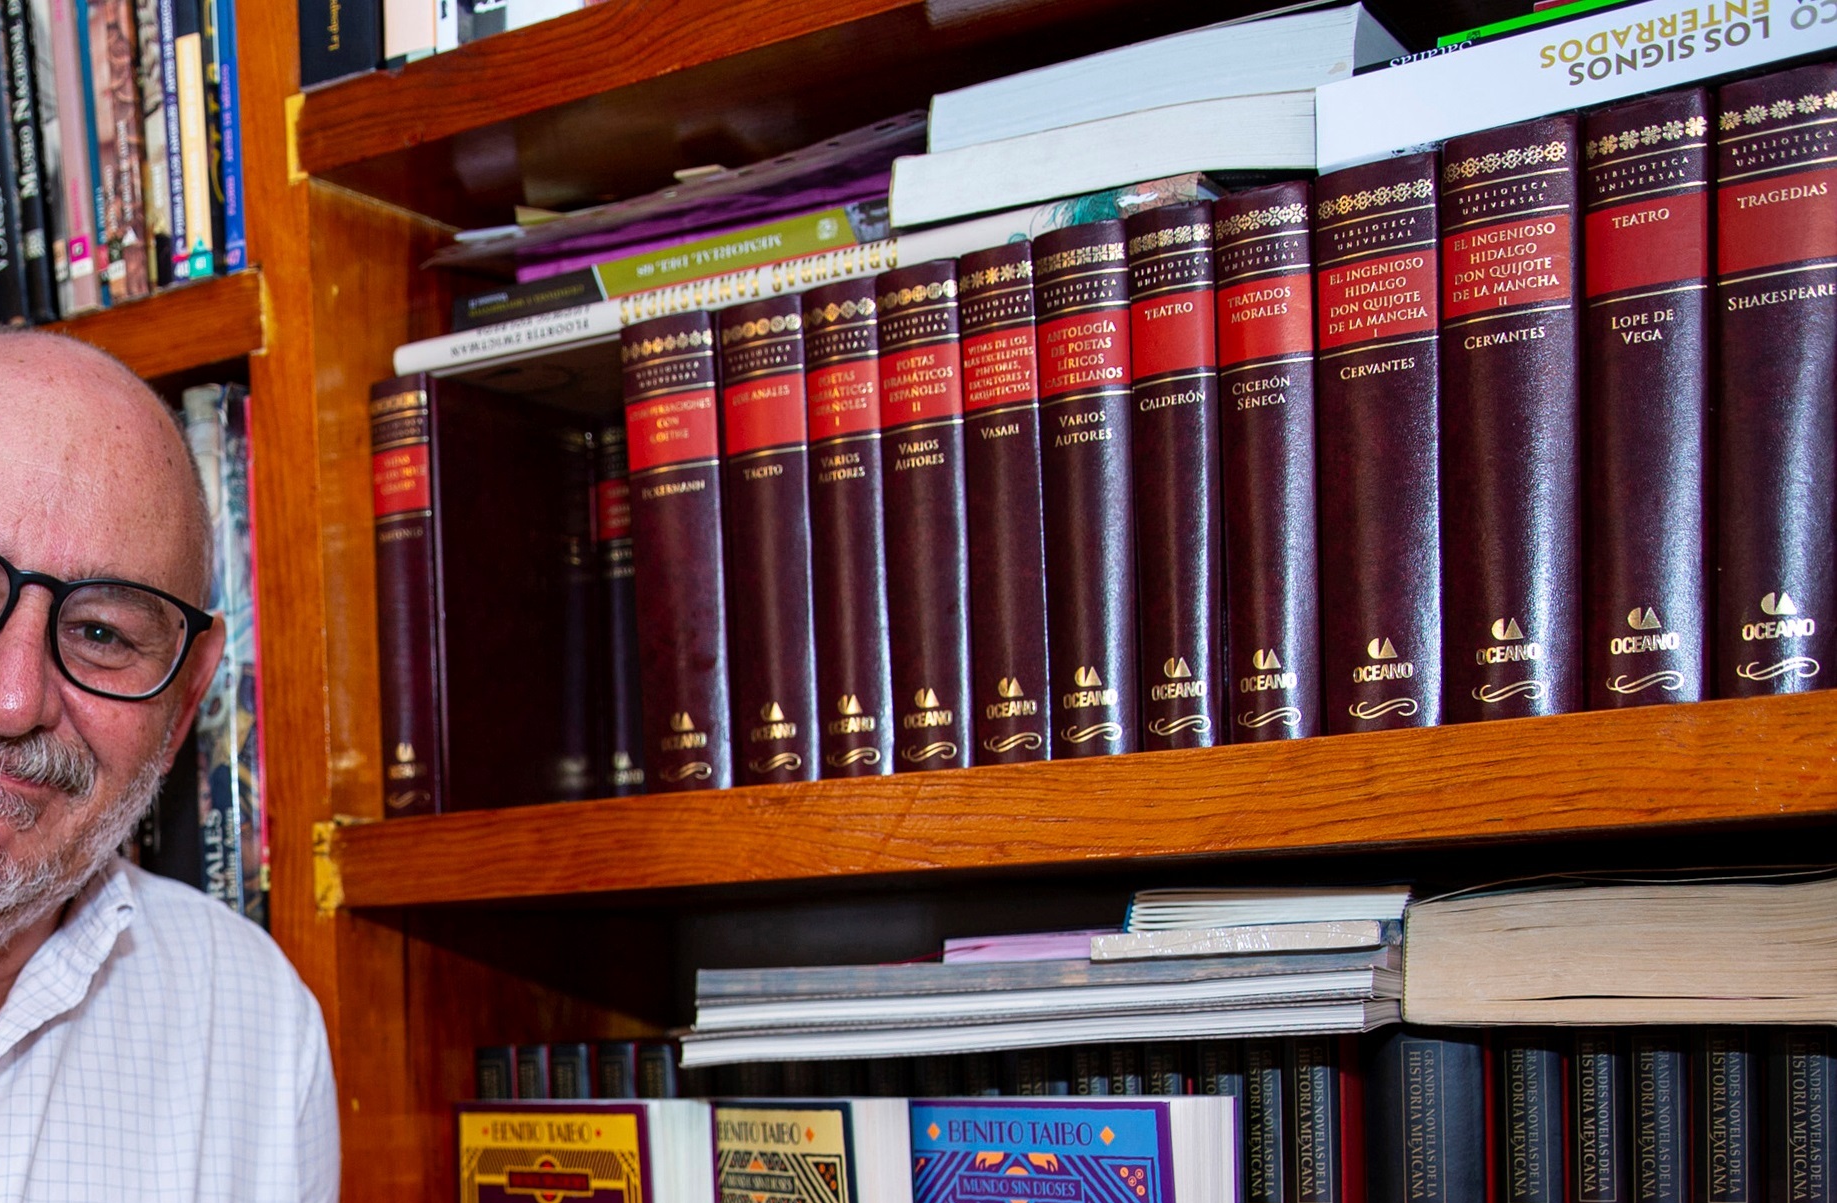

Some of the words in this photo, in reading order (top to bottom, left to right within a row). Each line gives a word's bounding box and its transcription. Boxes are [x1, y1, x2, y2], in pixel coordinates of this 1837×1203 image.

[1539, 0, 1770, 68] ENTERRADOS
[1706, 15, 1770, 52] LOS
[1568, 34, 1695, 85] SIGNOS
[1732, 129, 1835, 156] BIBLIOTECA
[1736, 142, 1830, 167] UNIVERSAL
[1737, 183, 1828, 210] TRAGEDIAS
[1333, 216, 1417, 241] BIBLIOTECA
[1612, 208, 1670, 229] TEATRO
[1337, 229, 1413, 251] UNIVERSAL
[772, 237, 898, 293] CRIATURAS
[1329, 273, 1344, 286] EL
[1346, 257, 1424, 283] INGENIOSO
[1227, 286, 1291, 310] TRATADOS
[1345, 276, 1407, 298] HIDALGO
[1728, 281, 1836, 312] SHAKESPEARE
[1145, 301, 1193, 321] TEATRO
[1230, 303, 1288, 324] MORALES
[1330, 303, 1359, 318] DON
[1362, 290, 1421, 316] QUIJOTE
[1329, 322, 1345, 335] DE
[1348, 317, 1363, 331] LA
[1366, 307, 1428, 329] MANCHA
[1611, 312, 1646, 330] LOPE
[1652, 308, 1675, 325] DE
[1046, 320, 1116, 344] ANTOLOGÍA
[1464, 325, 1546, 350] CERVANTES
[1620, 327, 1663, 346] VEGA
[1051, 345, 1065, 358] DE
[1068, 337, 1112, 355] POETAS
[1057, 352, 1104, 371] LÍRICOS
[1340, 357, 1415, 380] CERVANTES
[1044, 366, 1123, 389] CASTELLANOS
[1232, 375, 1291, 397] CICERÓN
[1139, 390, 1206, 412] CALDERÓN
[1237, 391, 1286, 410] SÉNECA
[1059, 411, 1106, 428] VARIOS
[981, 423, 1019, 440] VASARI
[1055, 428, 1113, 447] AUTORES
[1742, 618, 1816, 642] OCEANO
[1475, 643, 1542, 665] OCEANO
[1610, 632, 1680, 656] OCEANO
[1352, 662, 1414, 682] OCEANO
[1409, 1051, 1422, 1120] HISTORIA
[491, 1122, 543, 1142] BENITO
[547, 1123, 591, 1144] TAIBO
[717, 1122, 759, 1142] BENITO
[762, 1123, 801, 1145] TAIBO
[947, 1120, 1024, 1146] BENITO
[1027, 1121, 1093, 1147] TAIBO
[1407, 1125, 1424, 1199] MEXICANA
[962, 1177, 1008, 1196] MUNDO
[1012, 1179, 1029, 1195] SIN
[1032, 1180, 1076, 1198] DIOSES
